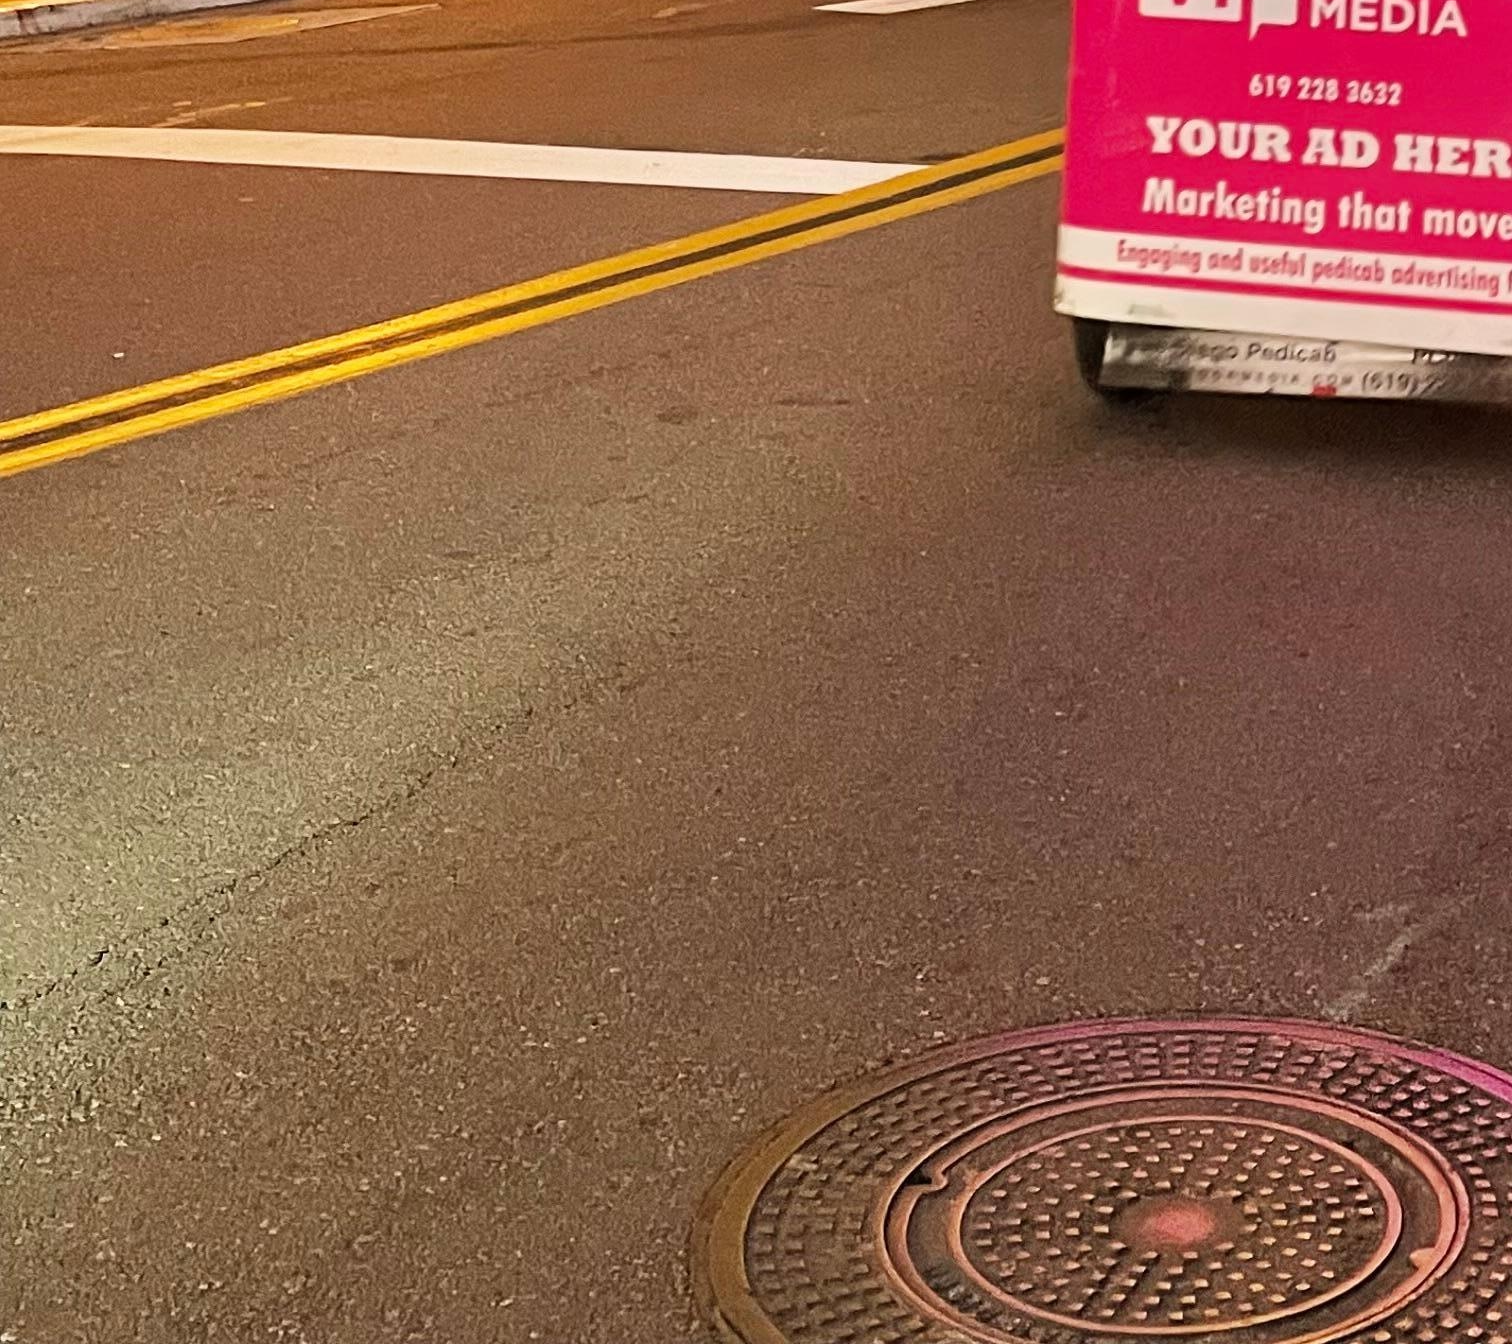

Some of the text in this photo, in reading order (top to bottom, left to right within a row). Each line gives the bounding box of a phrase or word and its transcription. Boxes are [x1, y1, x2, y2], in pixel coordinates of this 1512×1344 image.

[1249, 74, 1402, 106] 619 228 3632
[1146, 117, 1291, 163] YOUR
[1302, 129, 1379, 169] AD
[1143, 178, 1325, 235] Marketing
[1338, 192, 1410, 232] that
[1117, 240, 1201, 273] Engaging
[1208, 244, 1242, 273] and
[1249, 251, 1306, 277] useful
[1312, 258, 1385, 286] pedicab
[1392, 265, 1499, 299] advertising
[1246, 342, 1337, 363] Pedicab
